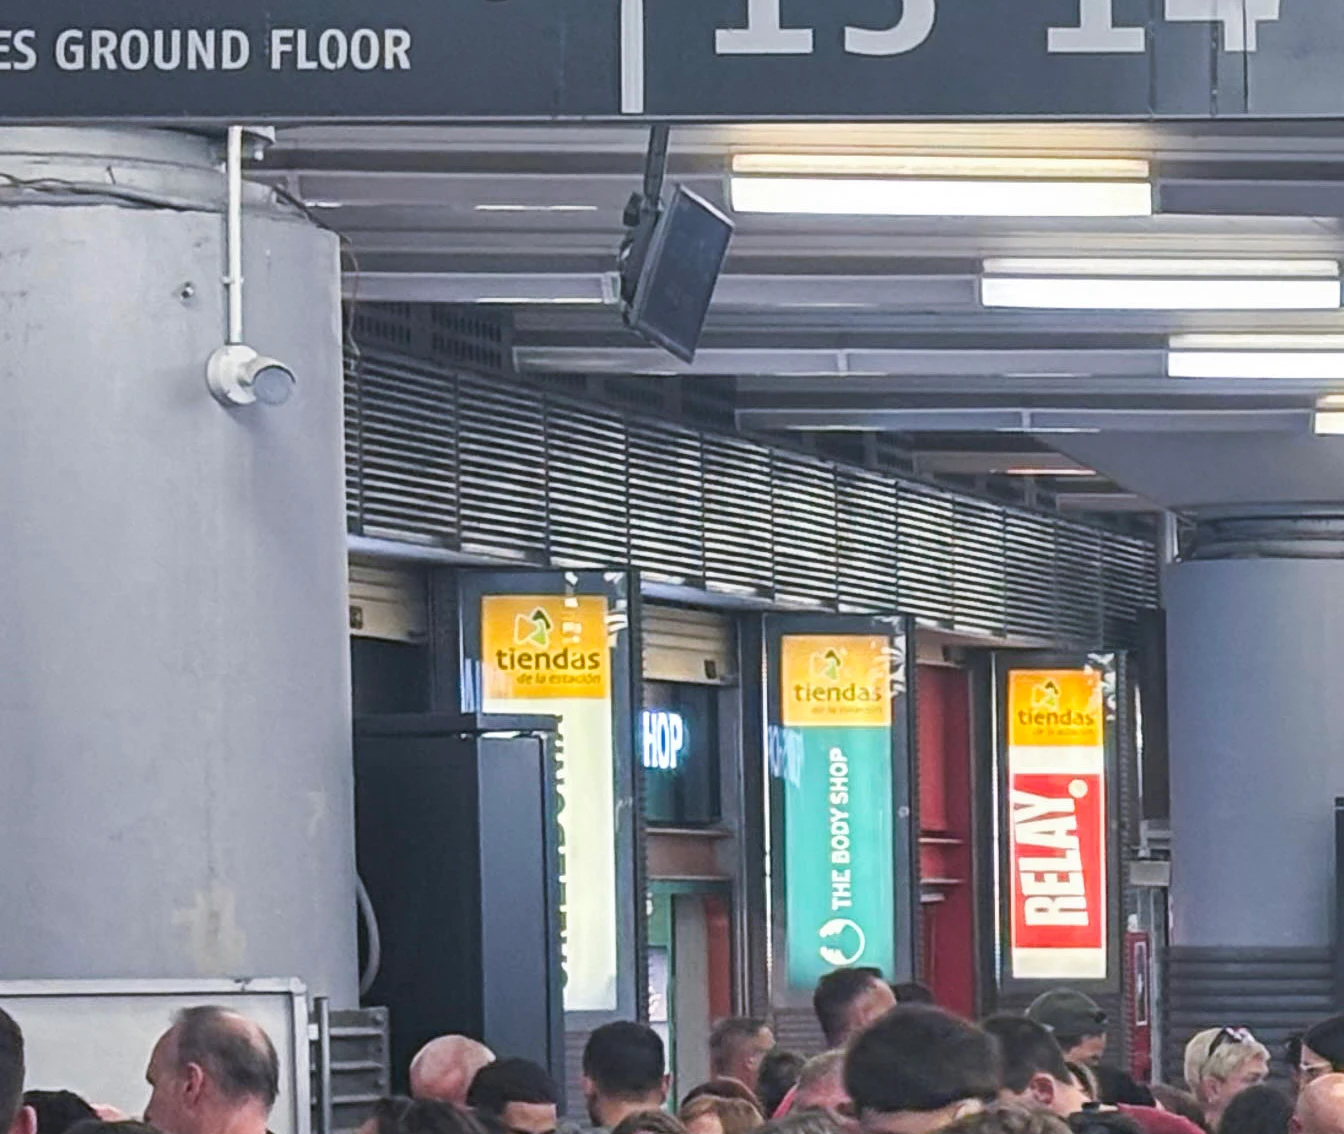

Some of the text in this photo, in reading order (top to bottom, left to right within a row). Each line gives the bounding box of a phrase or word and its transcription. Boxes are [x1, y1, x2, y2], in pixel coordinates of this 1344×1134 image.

[55, 28, 250, 71] GROUND
[271, 28, 412, 70] FLOOR
[496, 646, 600, 671] tiendas
[516, 672, 533, 685] de
[793, 681, 882, 702] tiendas
[1018, 708, 1095, 726] tiendas
[829, 747, 851, 911] THE BODY SHOP
